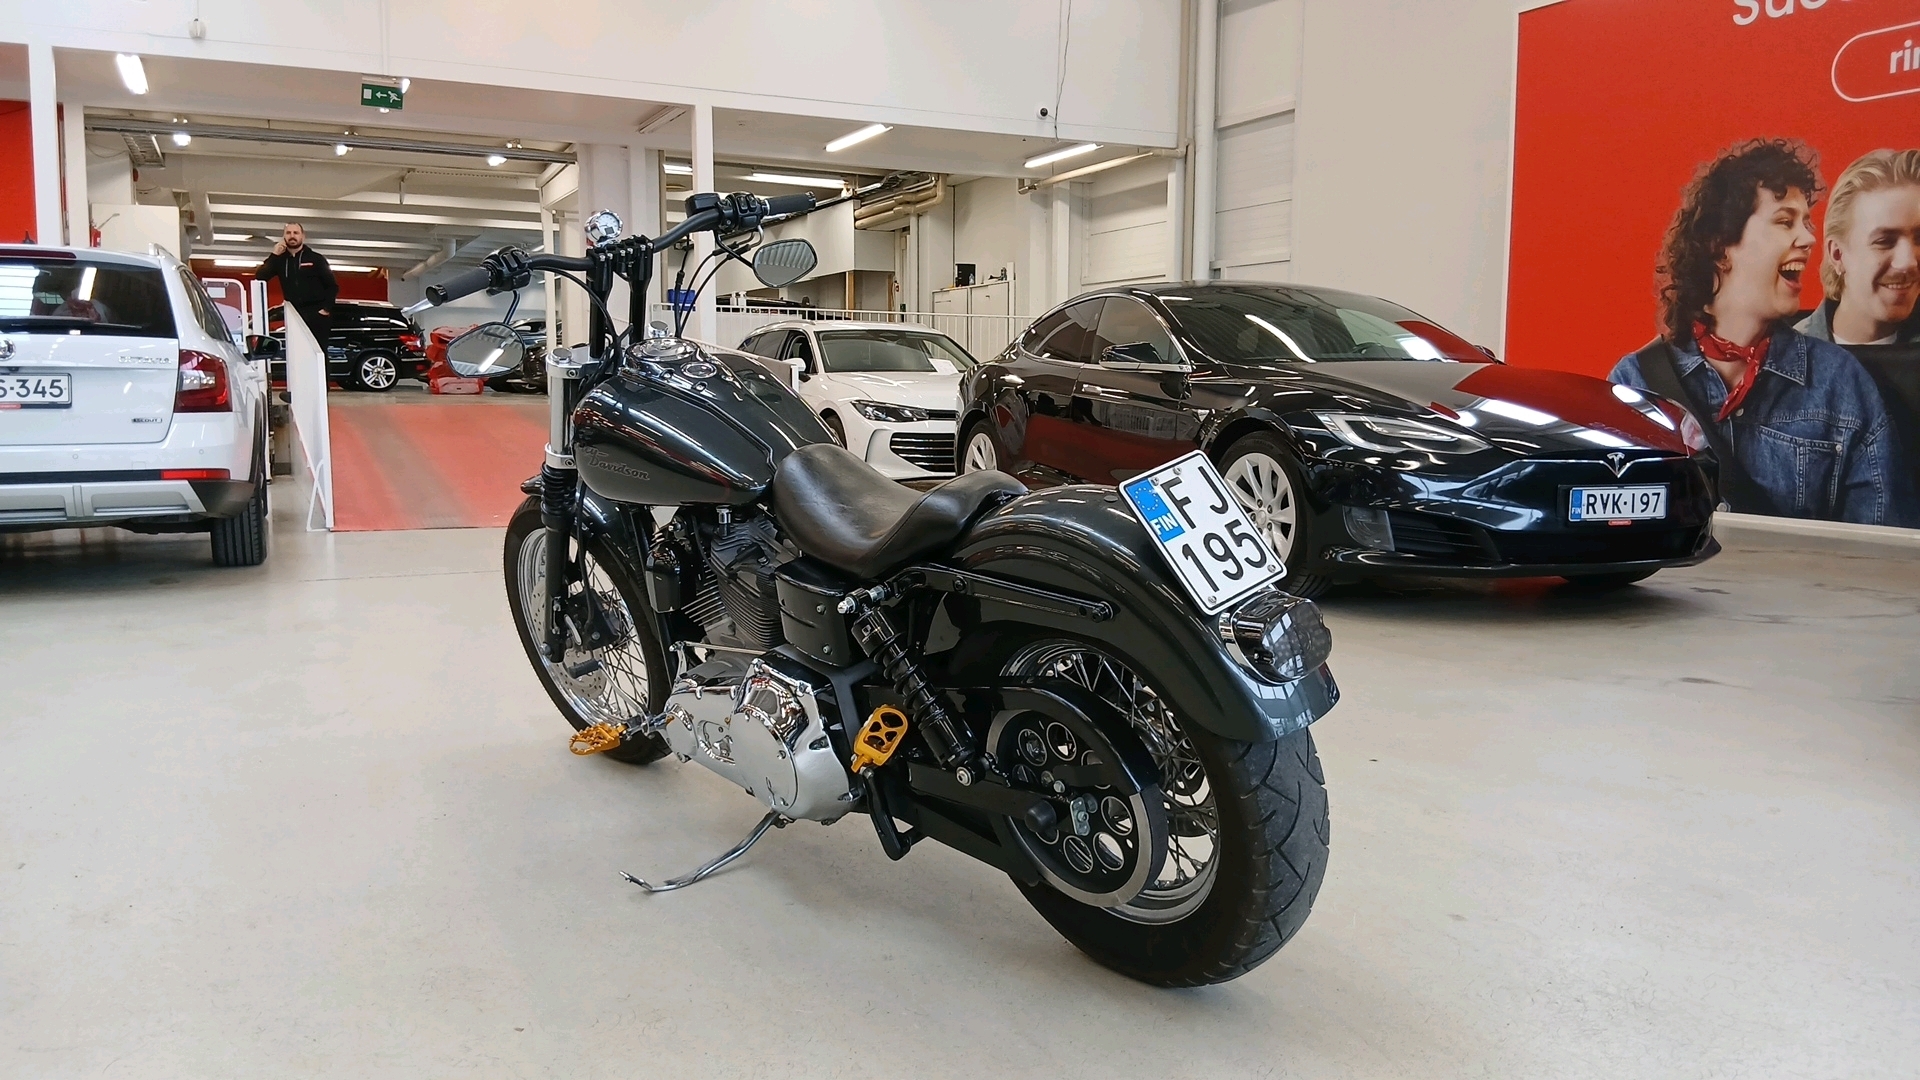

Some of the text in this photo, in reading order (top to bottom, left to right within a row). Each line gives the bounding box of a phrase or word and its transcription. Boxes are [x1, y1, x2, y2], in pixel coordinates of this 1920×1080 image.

[588, 456, 651, 481] Davidson
[1150, 513, 1179, 536] FIN
[1181, 518, 1268, 593] 195
